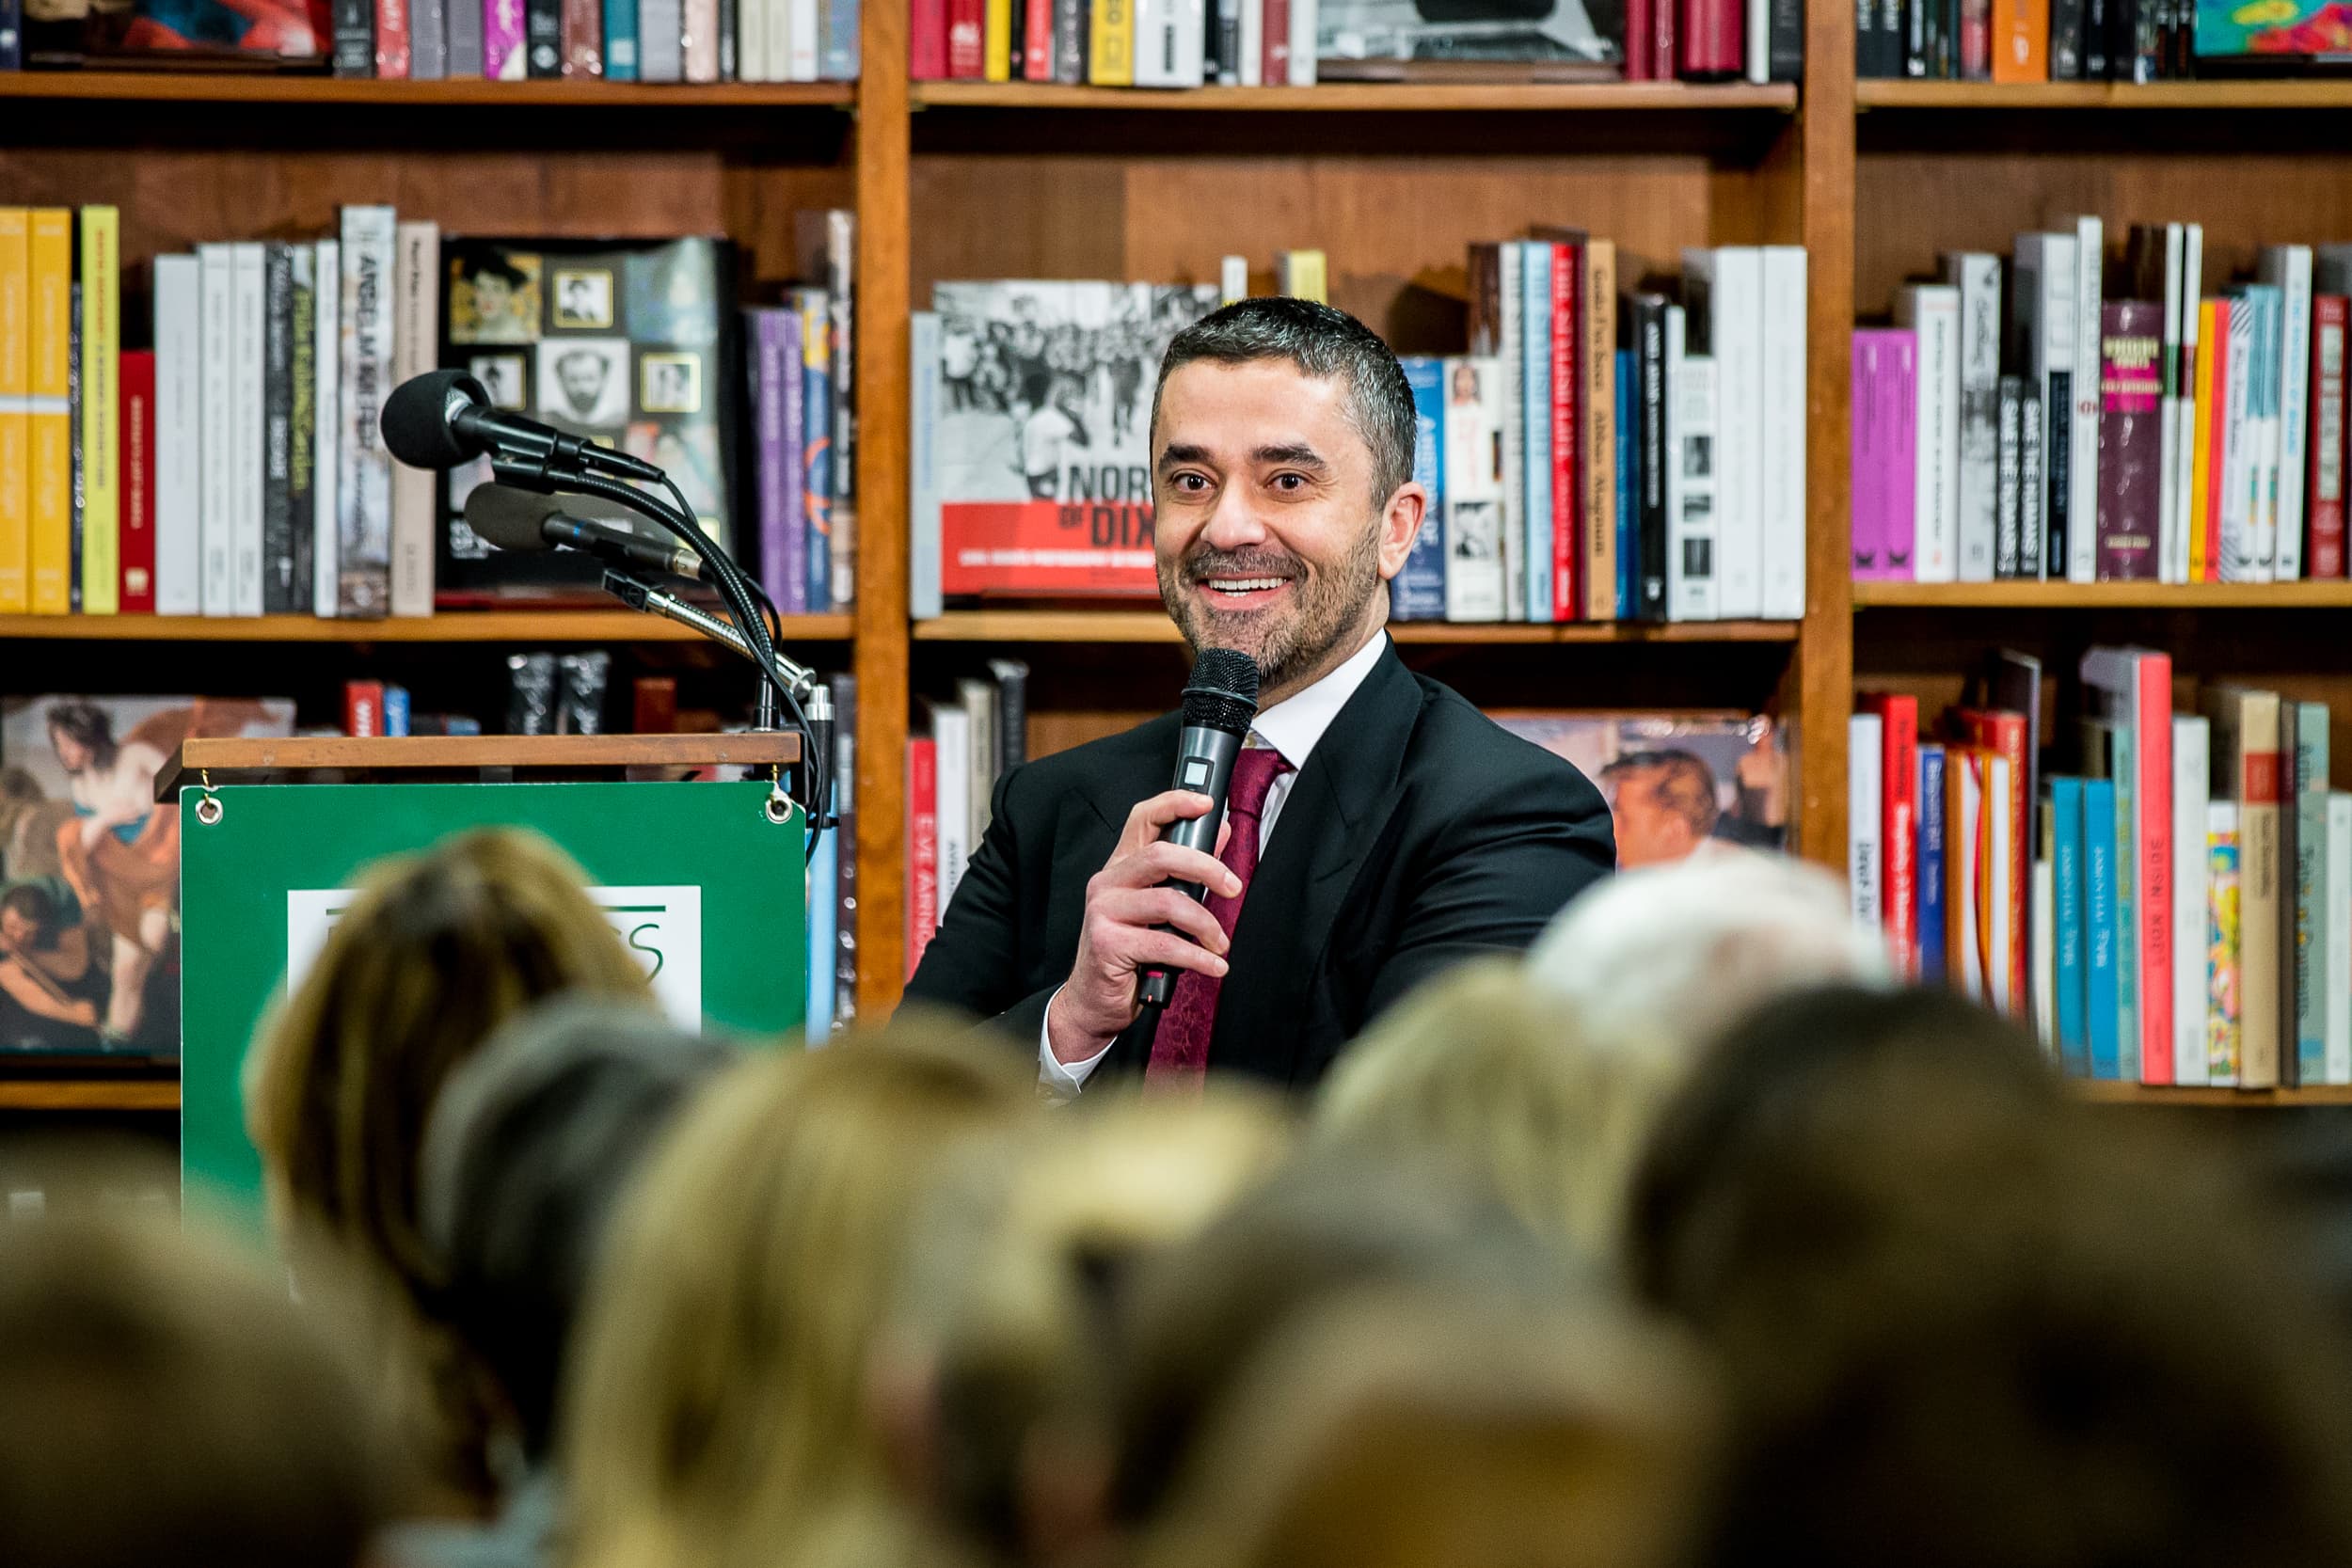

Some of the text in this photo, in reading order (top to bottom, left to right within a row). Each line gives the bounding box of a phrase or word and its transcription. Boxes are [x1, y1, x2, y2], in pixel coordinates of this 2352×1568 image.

[1069, 465, 1150, 503] NOR
[1091, 507, 1156, 547] DIX
[946, 841, 958, 892] AVEDO
[916, 873, 935, 950] ARNO
